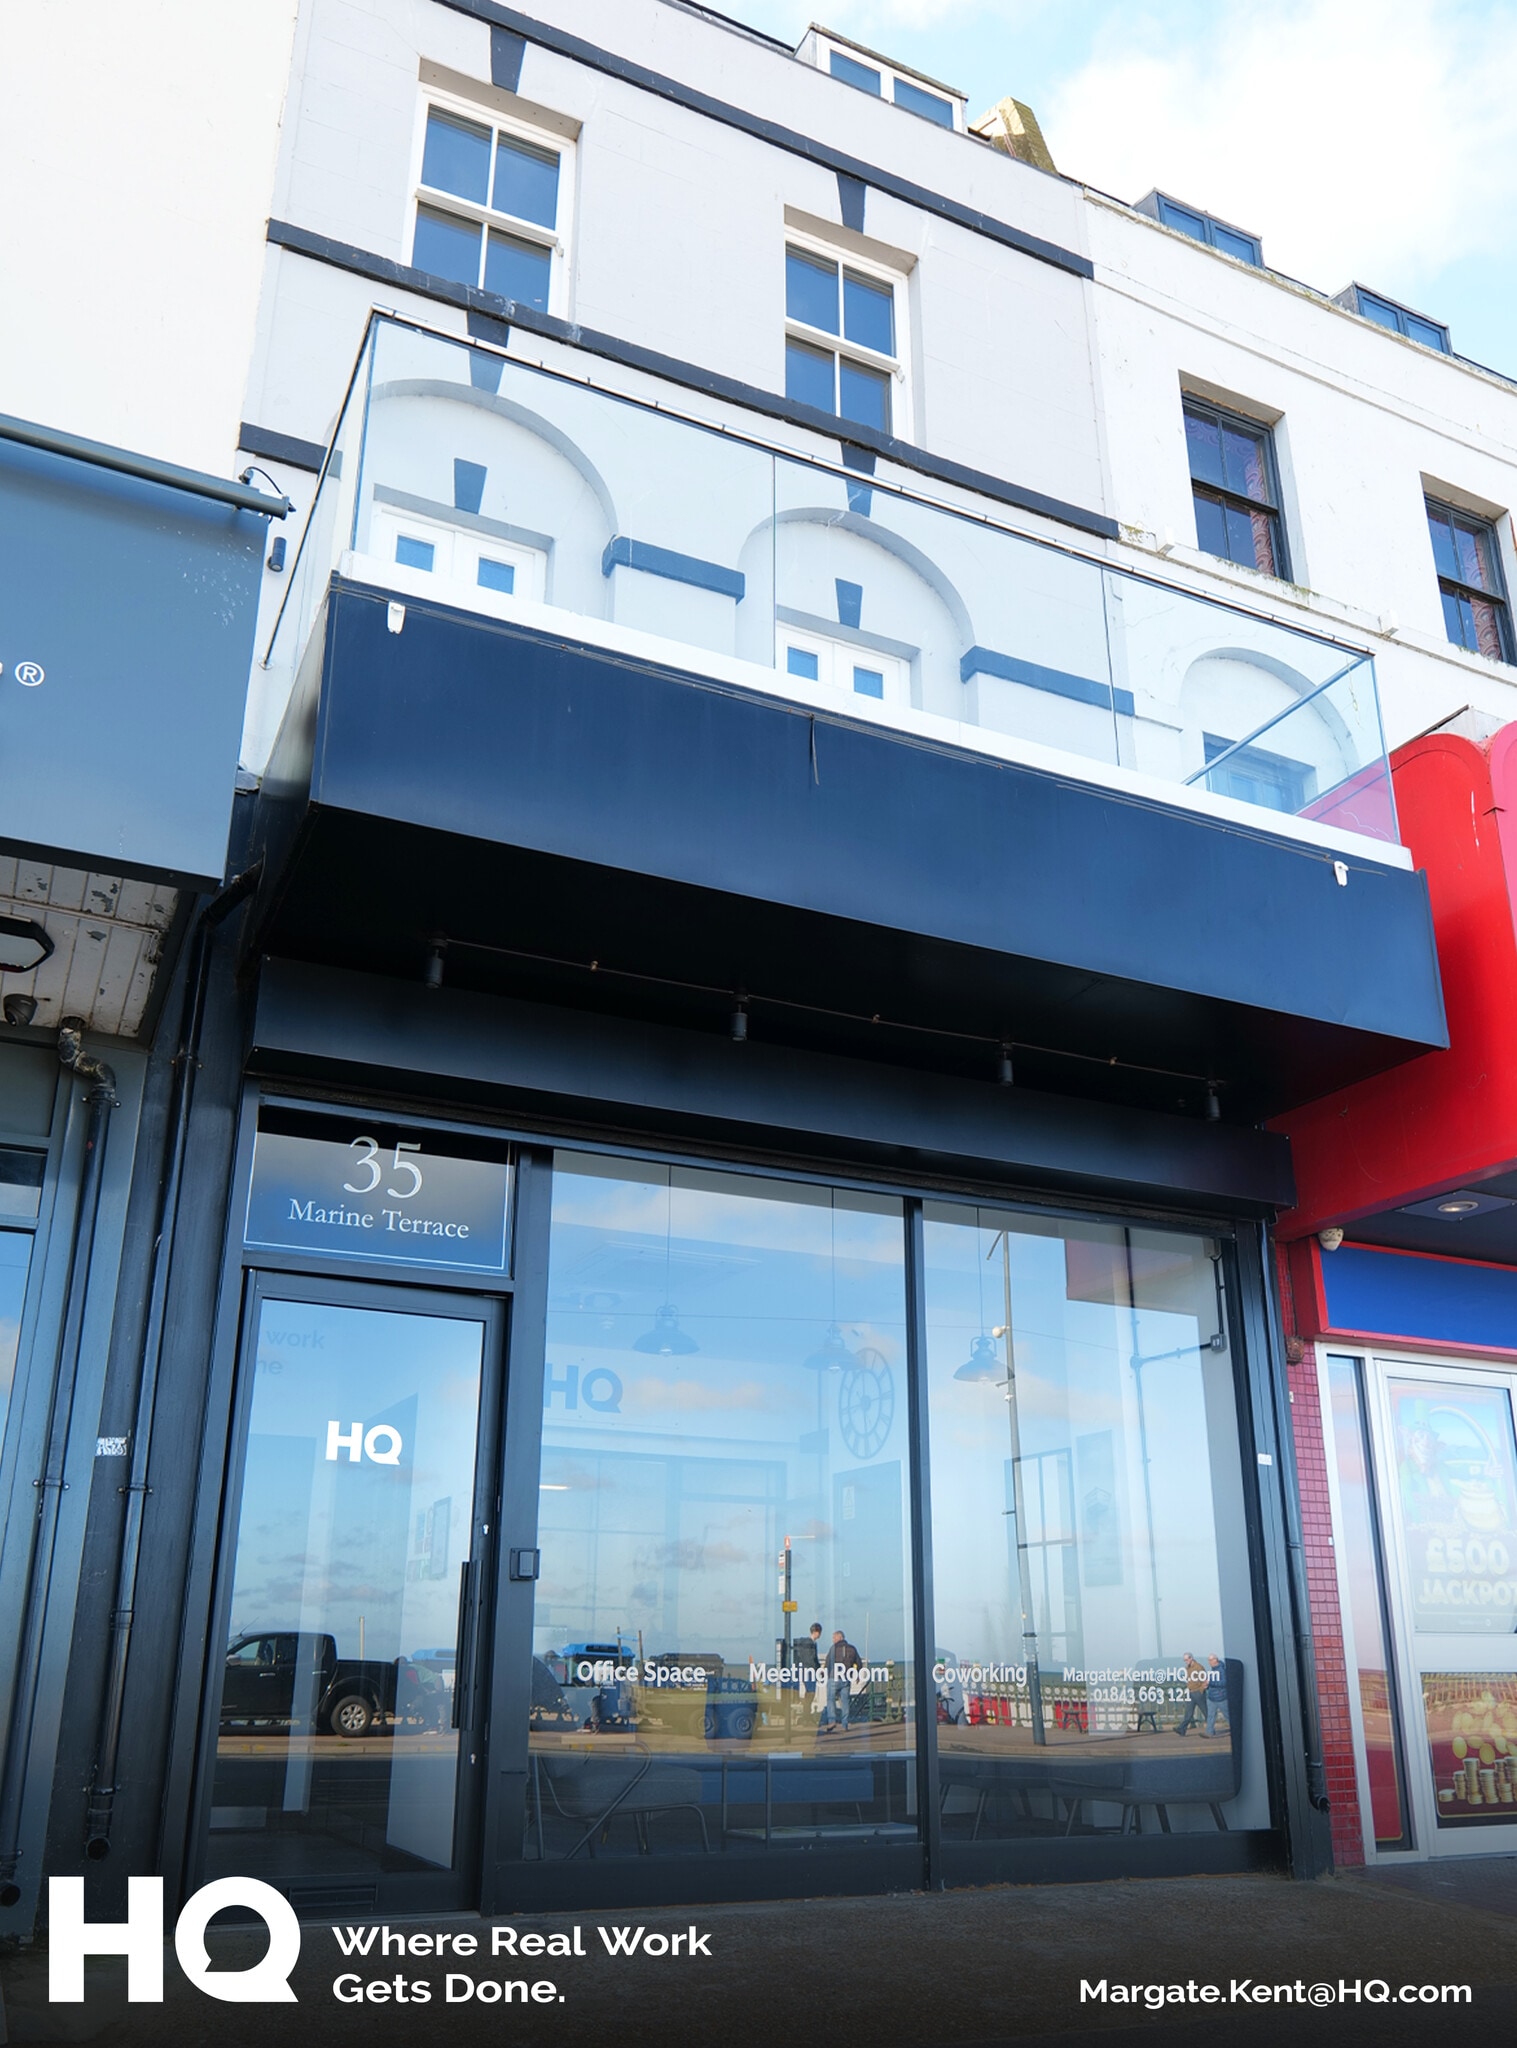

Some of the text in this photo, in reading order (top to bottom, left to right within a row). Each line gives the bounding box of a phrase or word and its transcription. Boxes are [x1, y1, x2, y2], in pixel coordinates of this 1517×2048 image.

[343, 1136, 423, 1199] 35
[287, 1198, 470, 1240] Marine Terrace
[543, 1362, 623, 1414] HQ
[325, 1420, 403, 1465] HQ
[1425, 1537, 1510, 1575] £500
[577, 1660, 706, 1687] Office Space
[749, 1662, 889, 1687] Meeting Room
[932, 1662, 1027, 1688] Coworking
[1063, 1667, 1220, 1686] Margate.Kent@HQ.com
[1093, 1686, 1192, 1705] 01843 663 121
